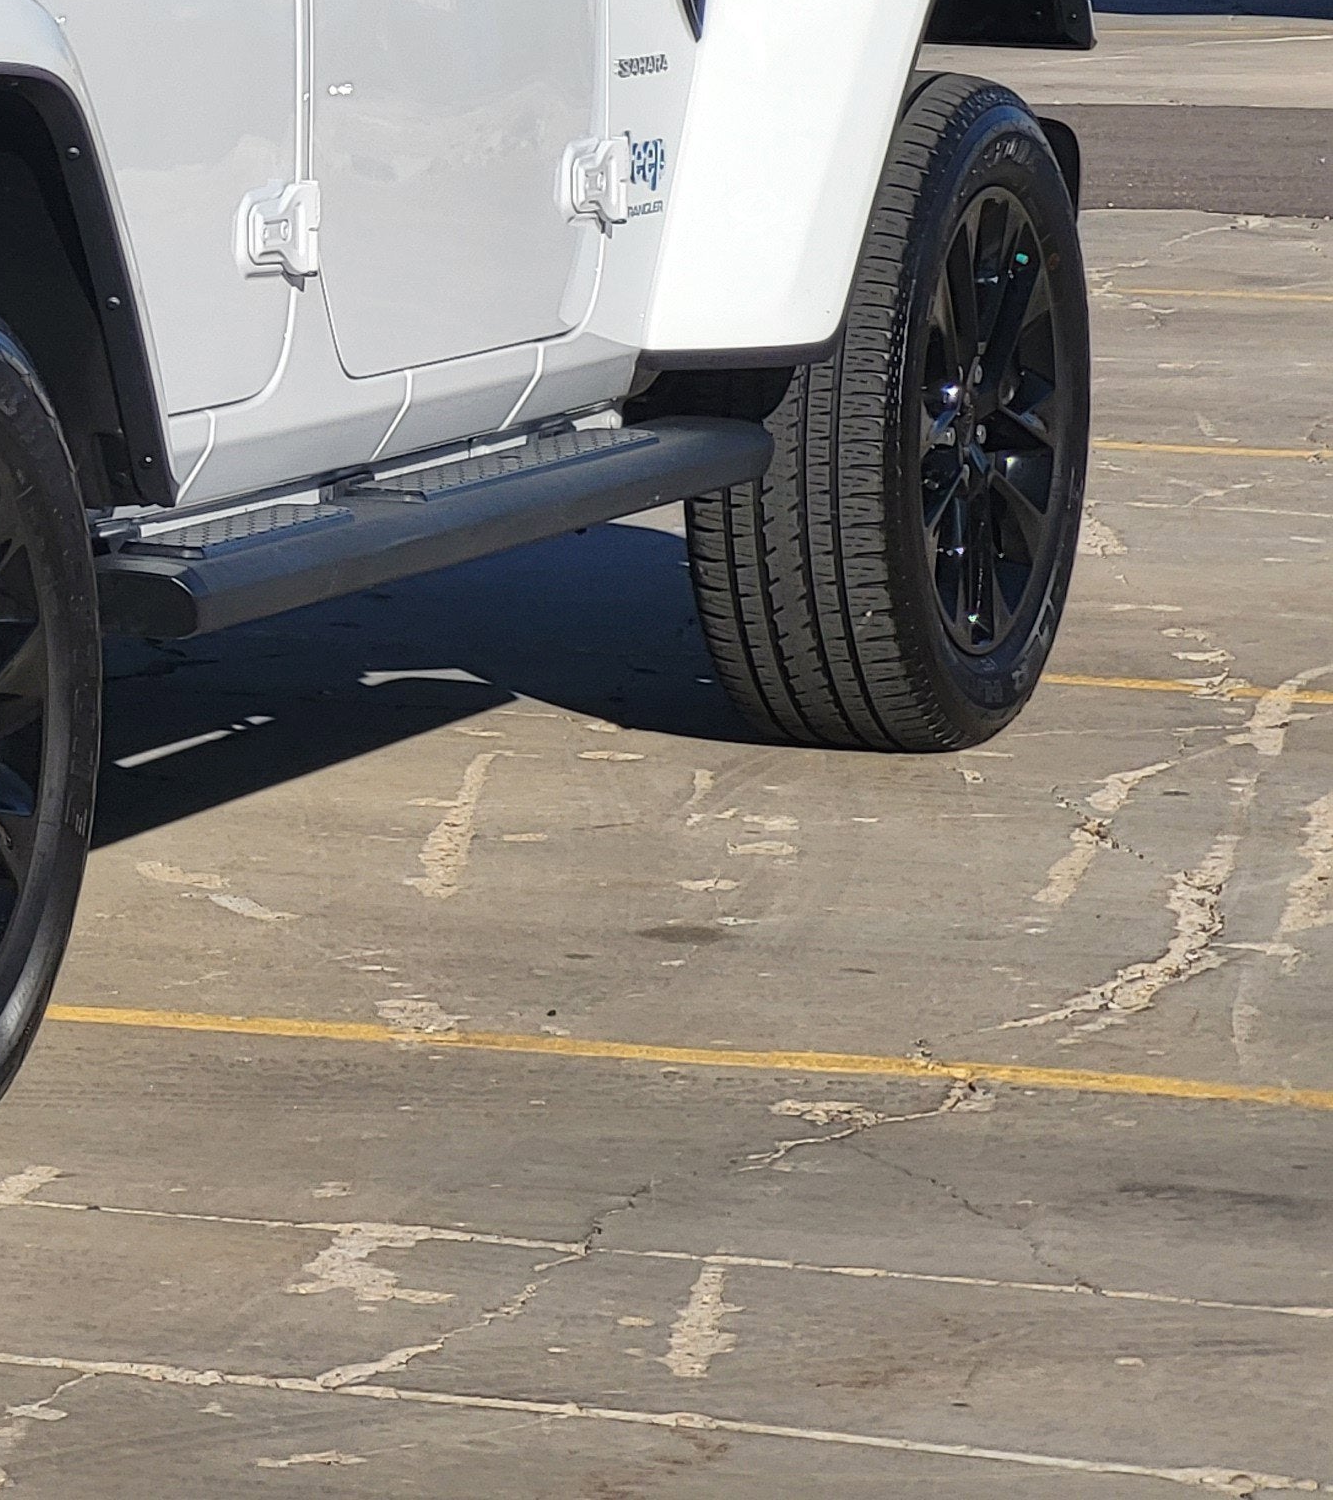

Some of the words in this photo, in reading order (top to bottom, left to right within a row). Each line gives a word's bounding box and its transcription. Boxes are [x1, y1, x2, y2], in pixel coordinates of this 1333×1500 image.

[617, 54, 668, 78] SAHARA
[624, 131, 665, 192] eep
[628, 200, 663, 218] RANGLER
